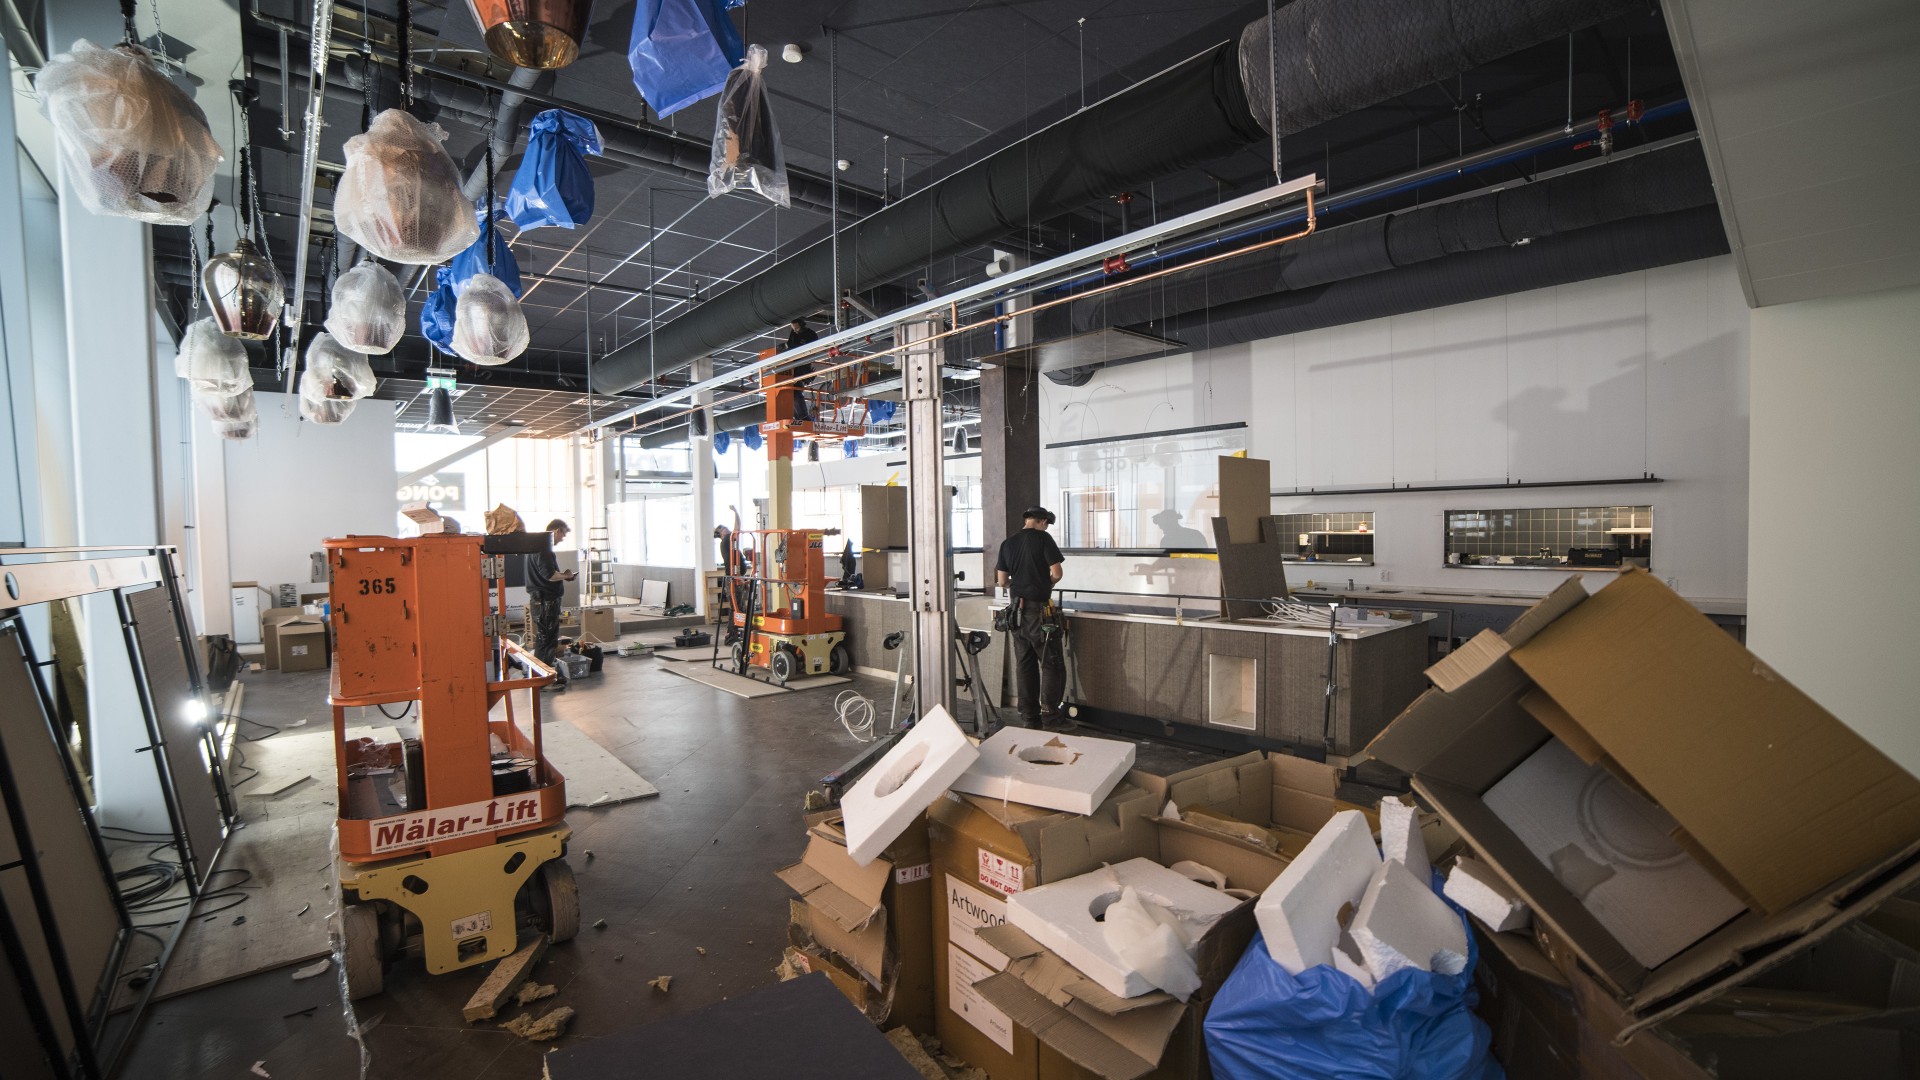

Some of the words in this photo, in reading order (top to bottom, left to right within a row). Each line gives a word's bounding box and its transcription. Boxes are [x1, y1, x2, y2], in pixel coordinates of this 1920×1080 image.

[359, 577, 396, 595] 365
[375, 799, 539, 848] Mälar-Lift
[980, 873, 989, 883] DO
[990, 878, 1003, 890] NOT
[952, 888, 1006, 928] Artwood
